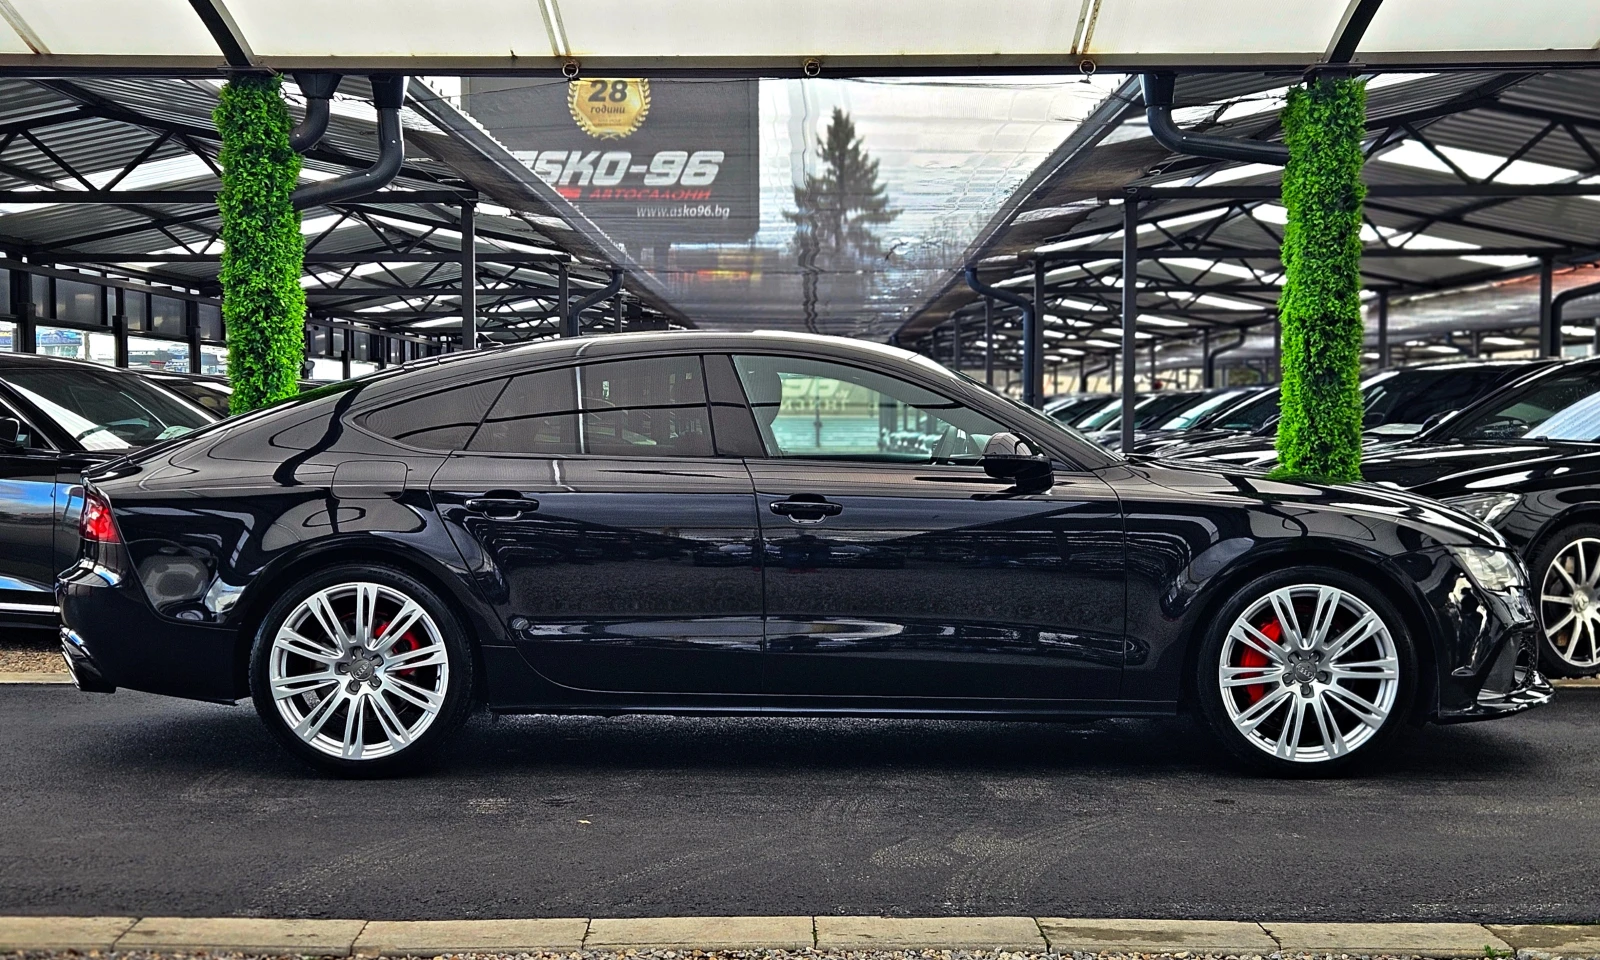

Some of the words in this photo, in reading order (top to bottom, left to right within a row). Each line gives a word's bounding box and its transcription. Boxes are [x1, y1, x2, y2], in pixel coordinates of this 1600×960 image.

[588, 80, 628, 103] 28
[590, 104, 626, 114] години
[590, 188, 713, 200] АВТОСАЛОНИ
[636, 205, 730, 219] www.asko96.bg
